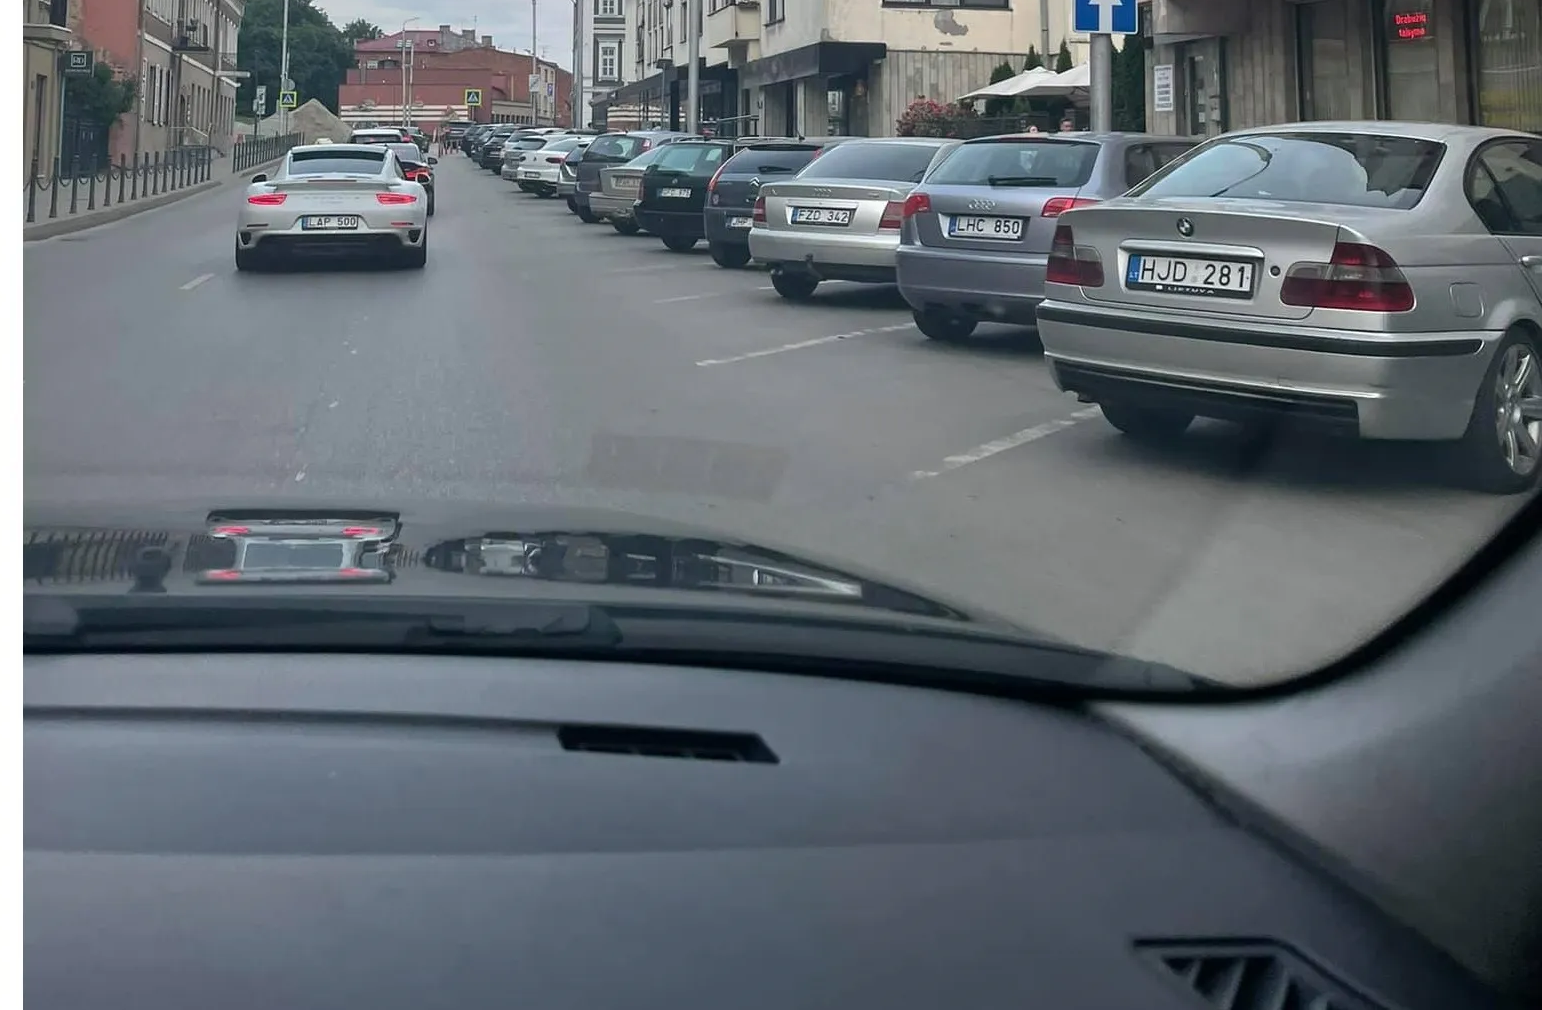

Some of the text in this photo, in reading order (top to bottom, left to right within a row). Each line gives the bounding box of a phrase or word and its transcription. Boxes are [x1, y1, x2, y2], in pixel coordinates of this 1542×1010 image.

[309, 217, 357, 227] LAP 500
[798, 209, 848, 223] FZD 342
[957, 217, 1021, 235] LHC 850
[1141, 258, 1188, 283] HJD
[1202, 263, 1246, 289] 281
